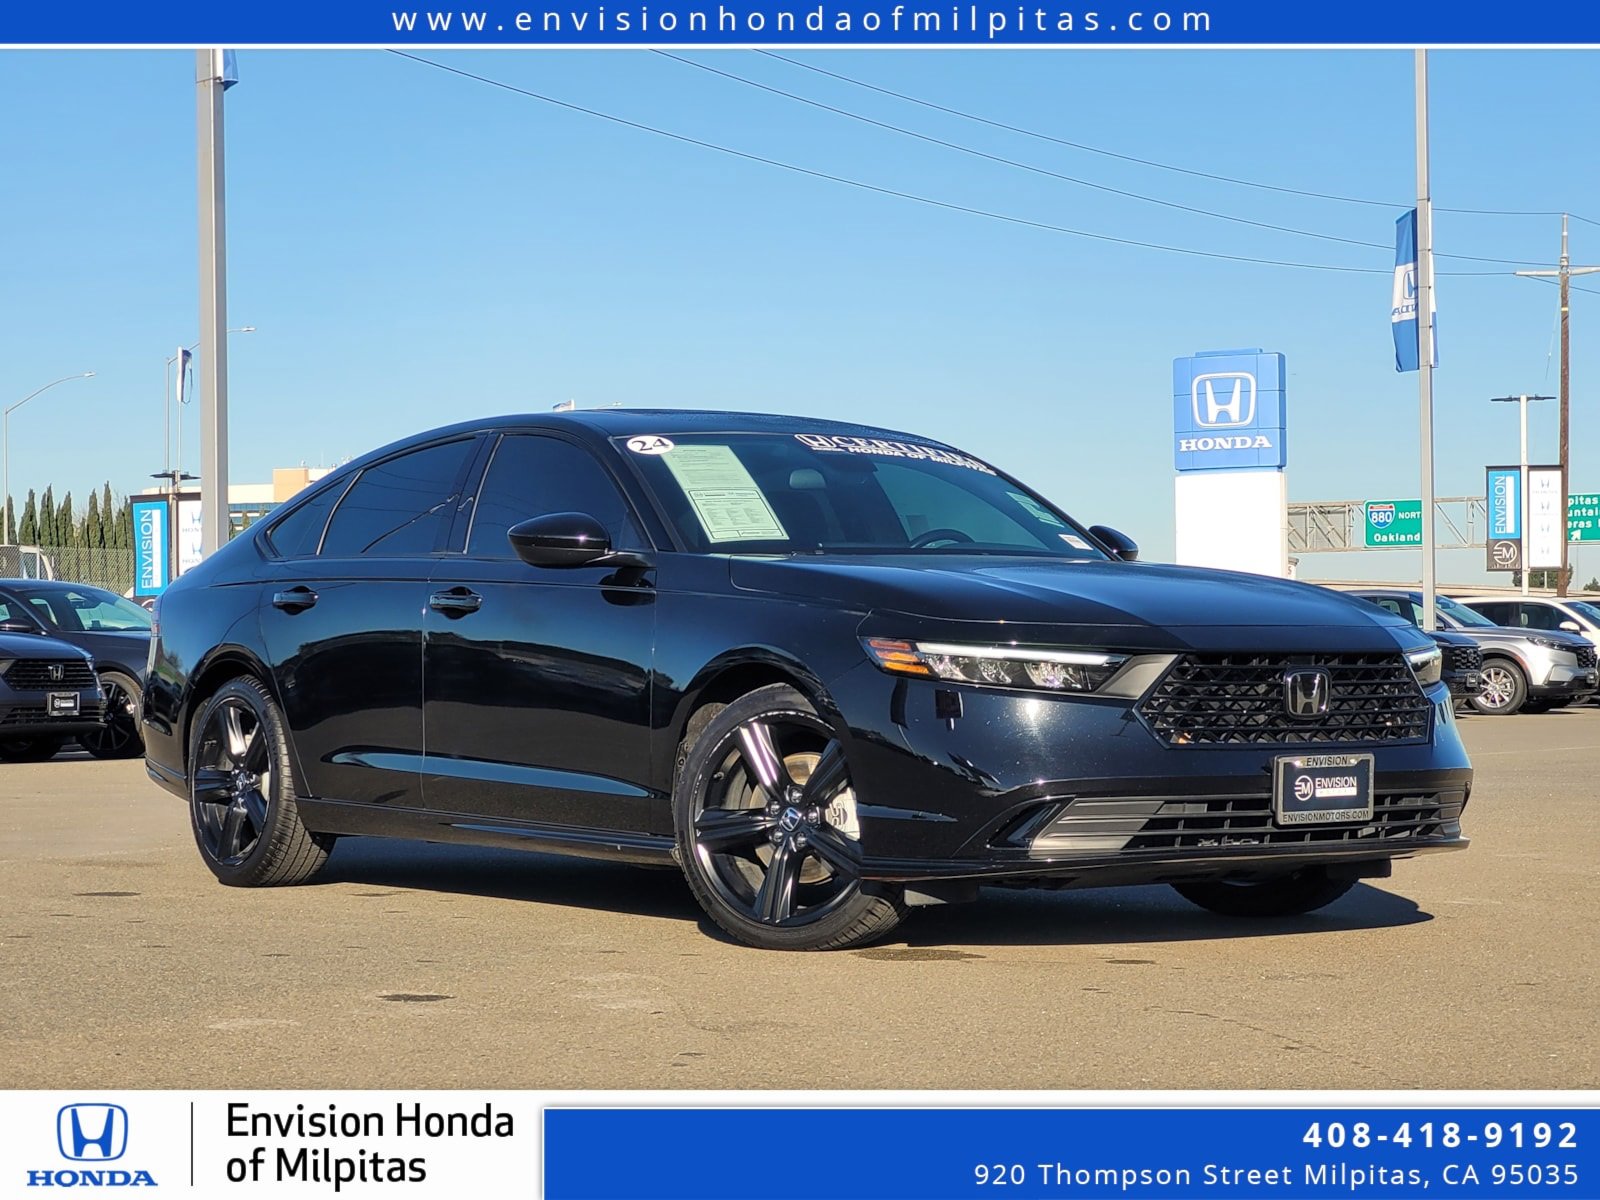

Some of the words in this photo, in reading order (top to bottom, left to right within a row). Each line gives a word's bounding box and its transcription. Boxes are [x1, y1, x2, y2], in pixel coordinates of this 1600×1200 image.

[631, 438, 669, 452] 24
[1179, 436, 1273, 452] HONDA
[848, 447, 905, 458] HONDA
[906, 451, 928, 460] OF
[1494, 475, 1506, 534] ENVISION
[1567, 495, 1599, 508] pitas
[1371, 511, 1393, 523] 880
[1398, 511, 1422, 519] NORT
[1373, 533, 1421, 543] Oakland
[141, 509, 153, 589] ENVISION
[1306, 756, 1348, 767] ENVISION
[1315, 776, 1357, 789] ENVISION
[1282, 810, 1369, 823] ENVISIONMOTORS.COM
